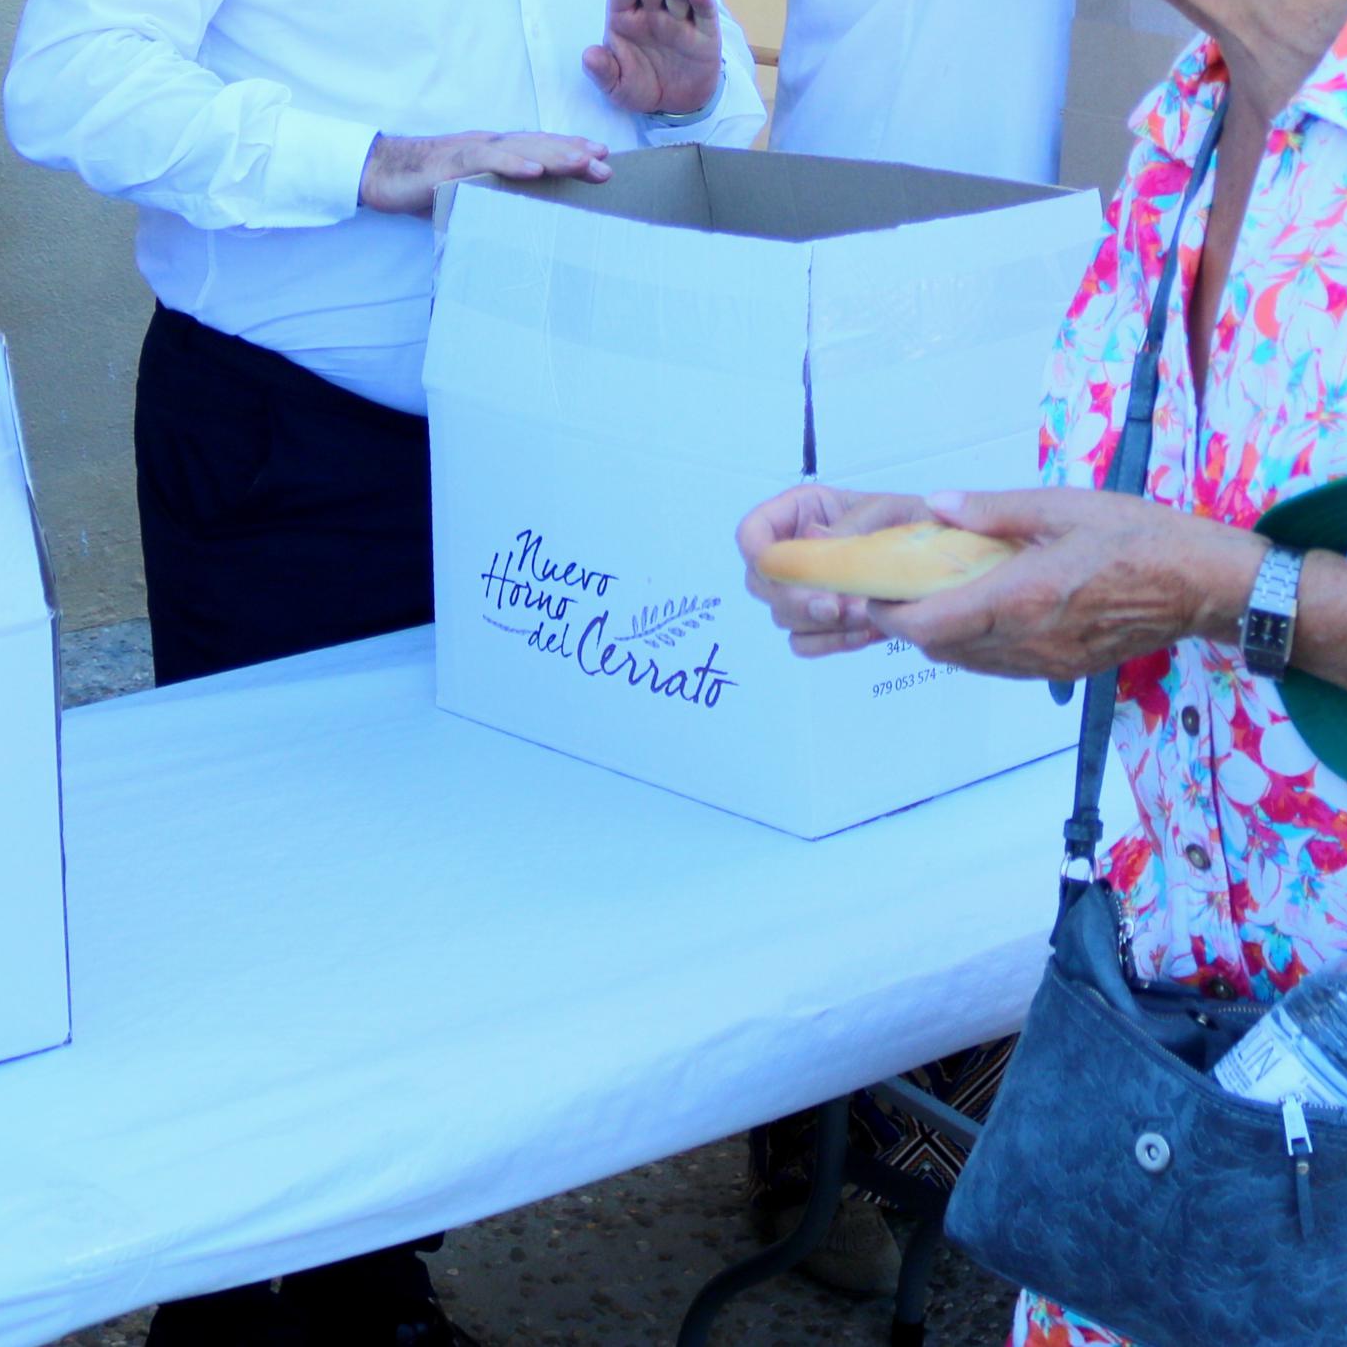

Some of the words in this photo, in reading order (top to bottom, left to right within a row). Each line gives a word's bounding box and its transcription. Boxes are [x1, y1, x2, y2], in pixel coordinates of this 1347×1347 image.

[481, 551, 579, 620] Horno
[517, 529, 620, 597] Nuevo
[528, 621, 573, 658] del
[577, 610, 740, 708] Cerrato
[872, 680, 893, 698] 979
[895, 673, 915, 691] 053
[917, 667, 936, 685] 574
